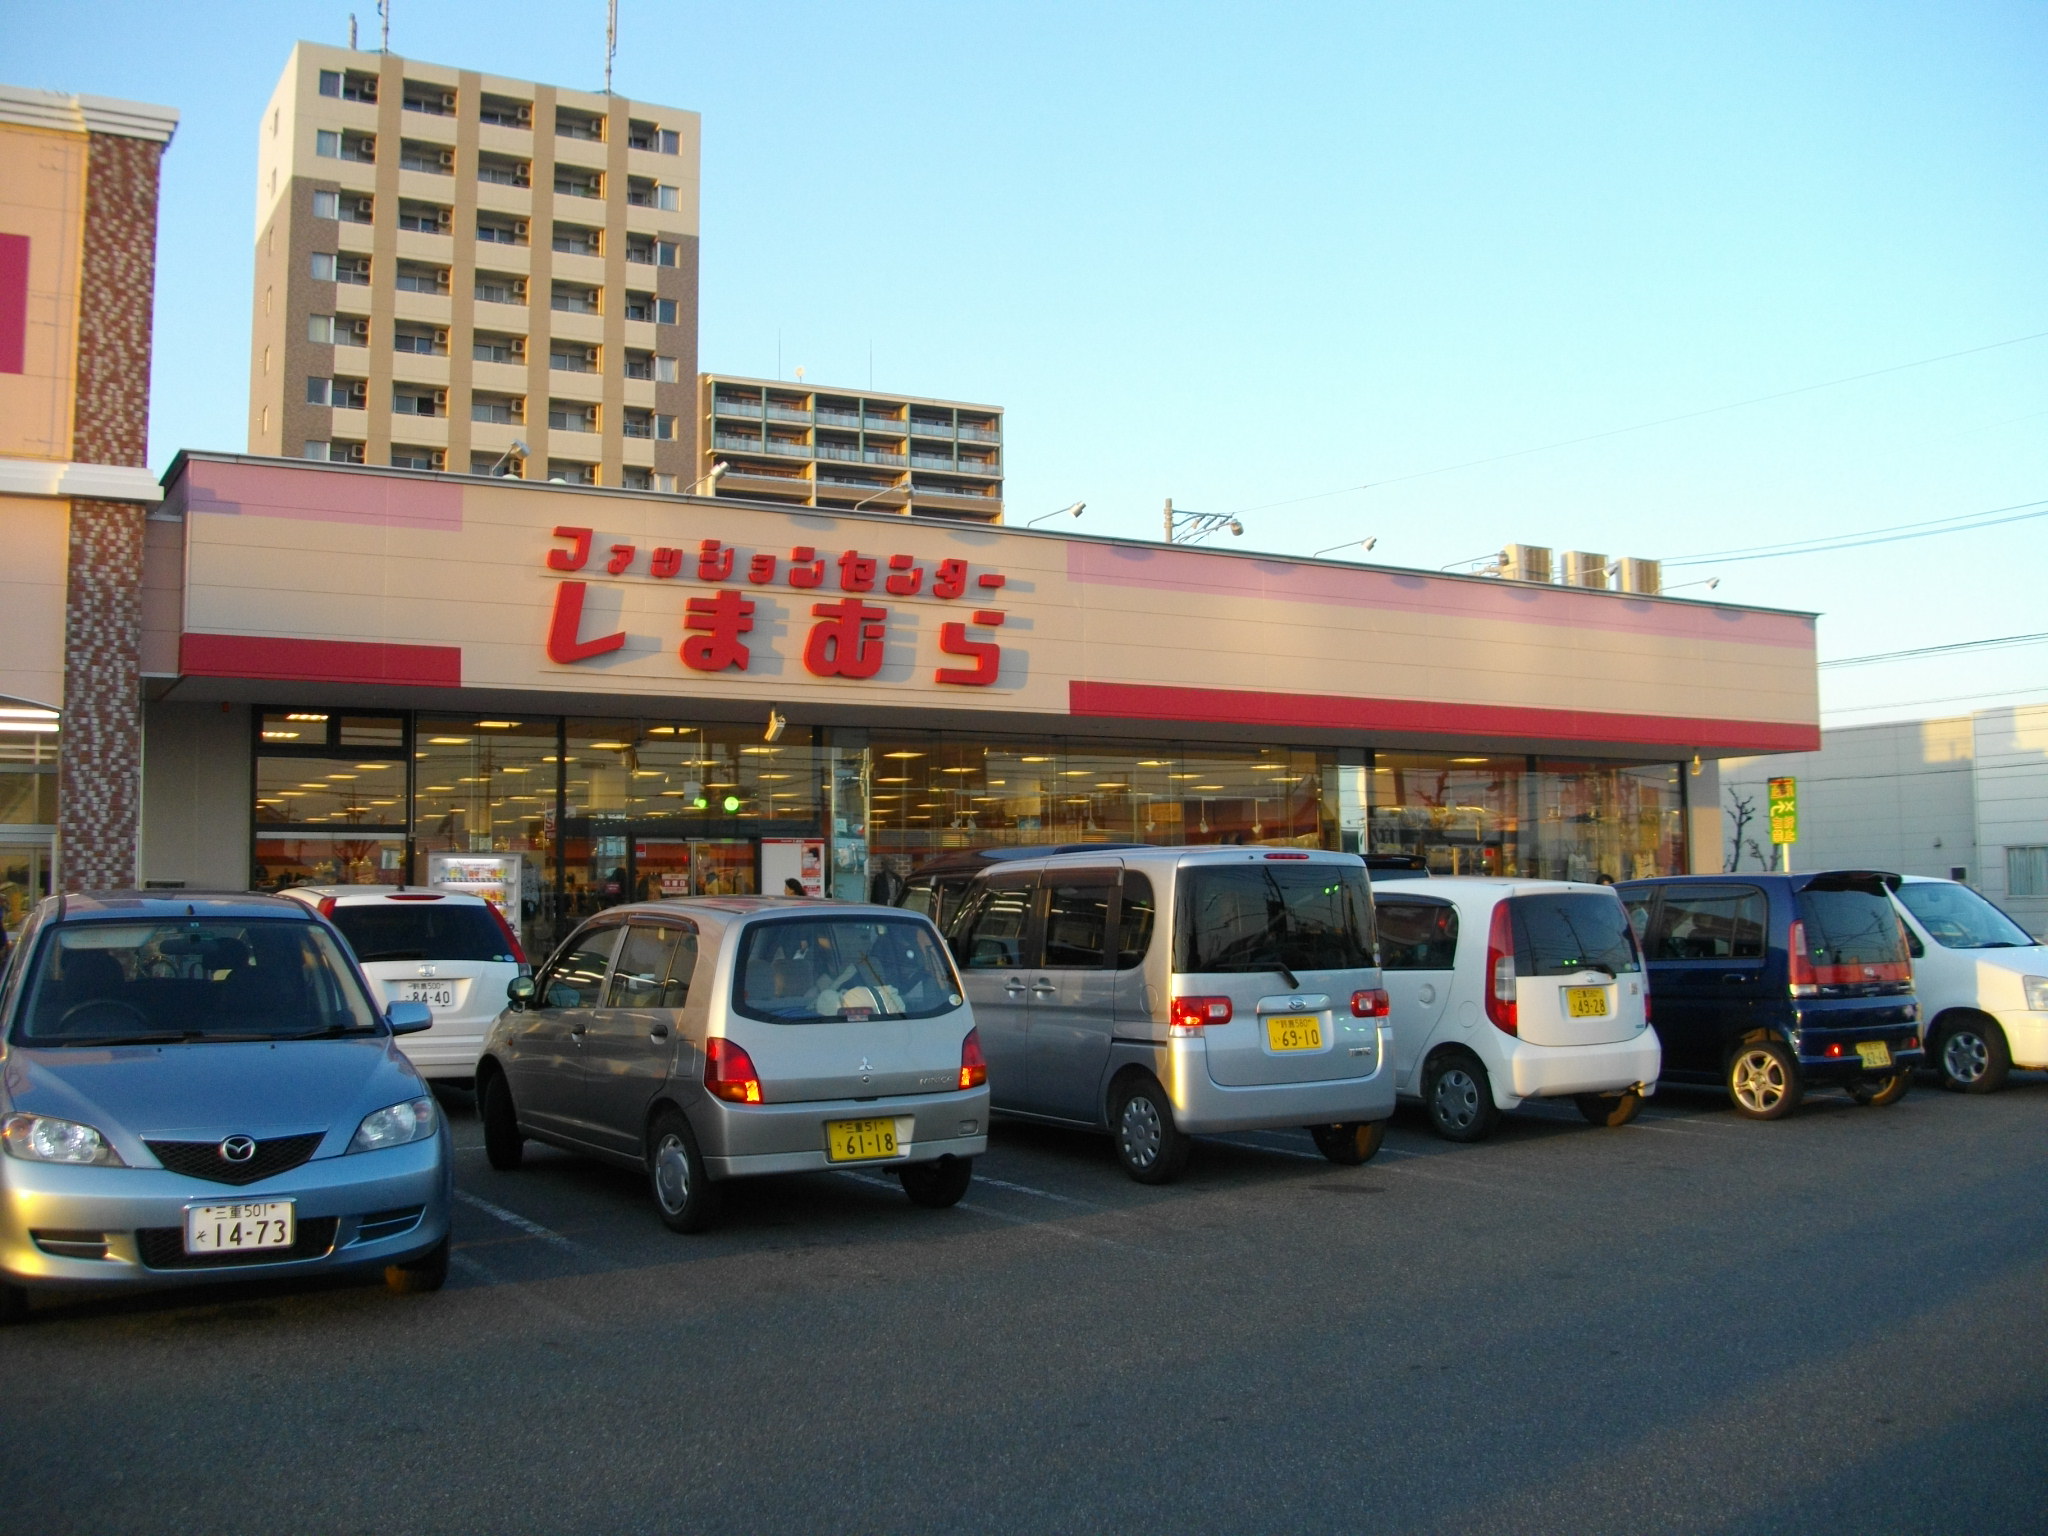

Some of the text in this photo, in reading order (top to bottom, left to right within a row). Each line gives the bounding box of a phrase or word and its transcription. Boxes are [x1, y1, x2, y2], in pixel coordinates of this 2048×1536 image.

[547, 525, 1006, 600] ファッションセンター
[547, 580, 1006, 686] しまむら
[412, 990, 450, 1004] 84-40
[1282, 1029, 1319, 1047] 69-10
[846, 1132, 894, 1155] 61-18
[216, 1219, 287, 1248] 14-73
